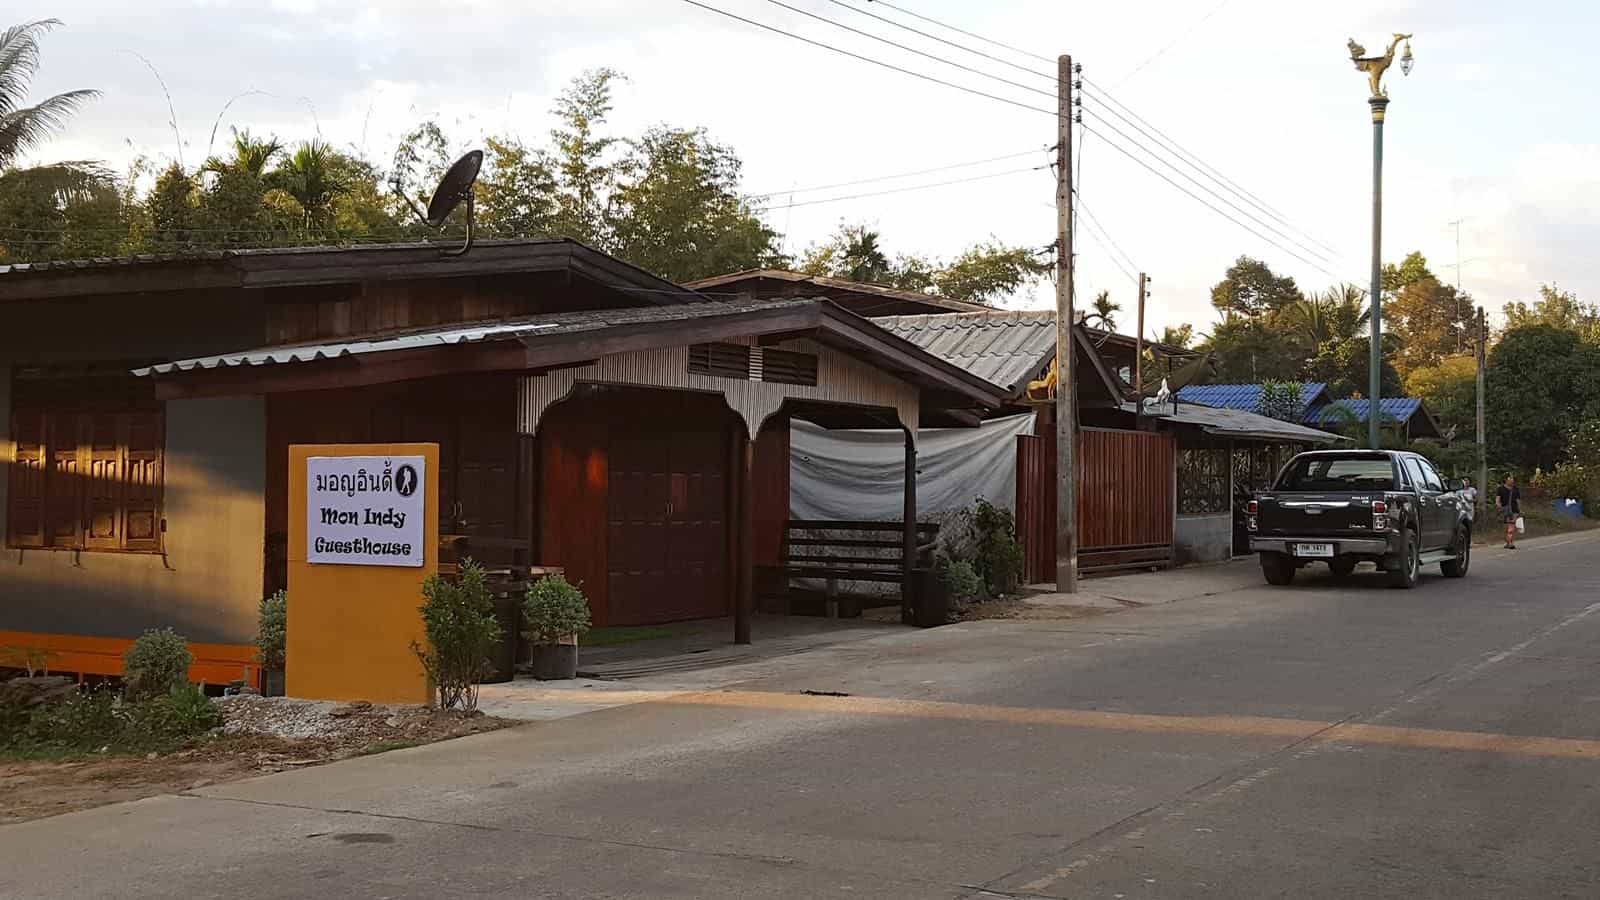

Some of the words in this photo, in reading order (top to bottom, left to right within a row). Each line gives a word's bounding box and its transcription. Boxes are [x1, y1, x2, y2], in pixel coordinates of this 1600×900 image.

[316, 458, 393, 498] มอญอินดี้
[320, 507, 359, 526] Mon
[363, 507, 406, 529] Indy
[315, 536, 412, 556] Guesthouse
